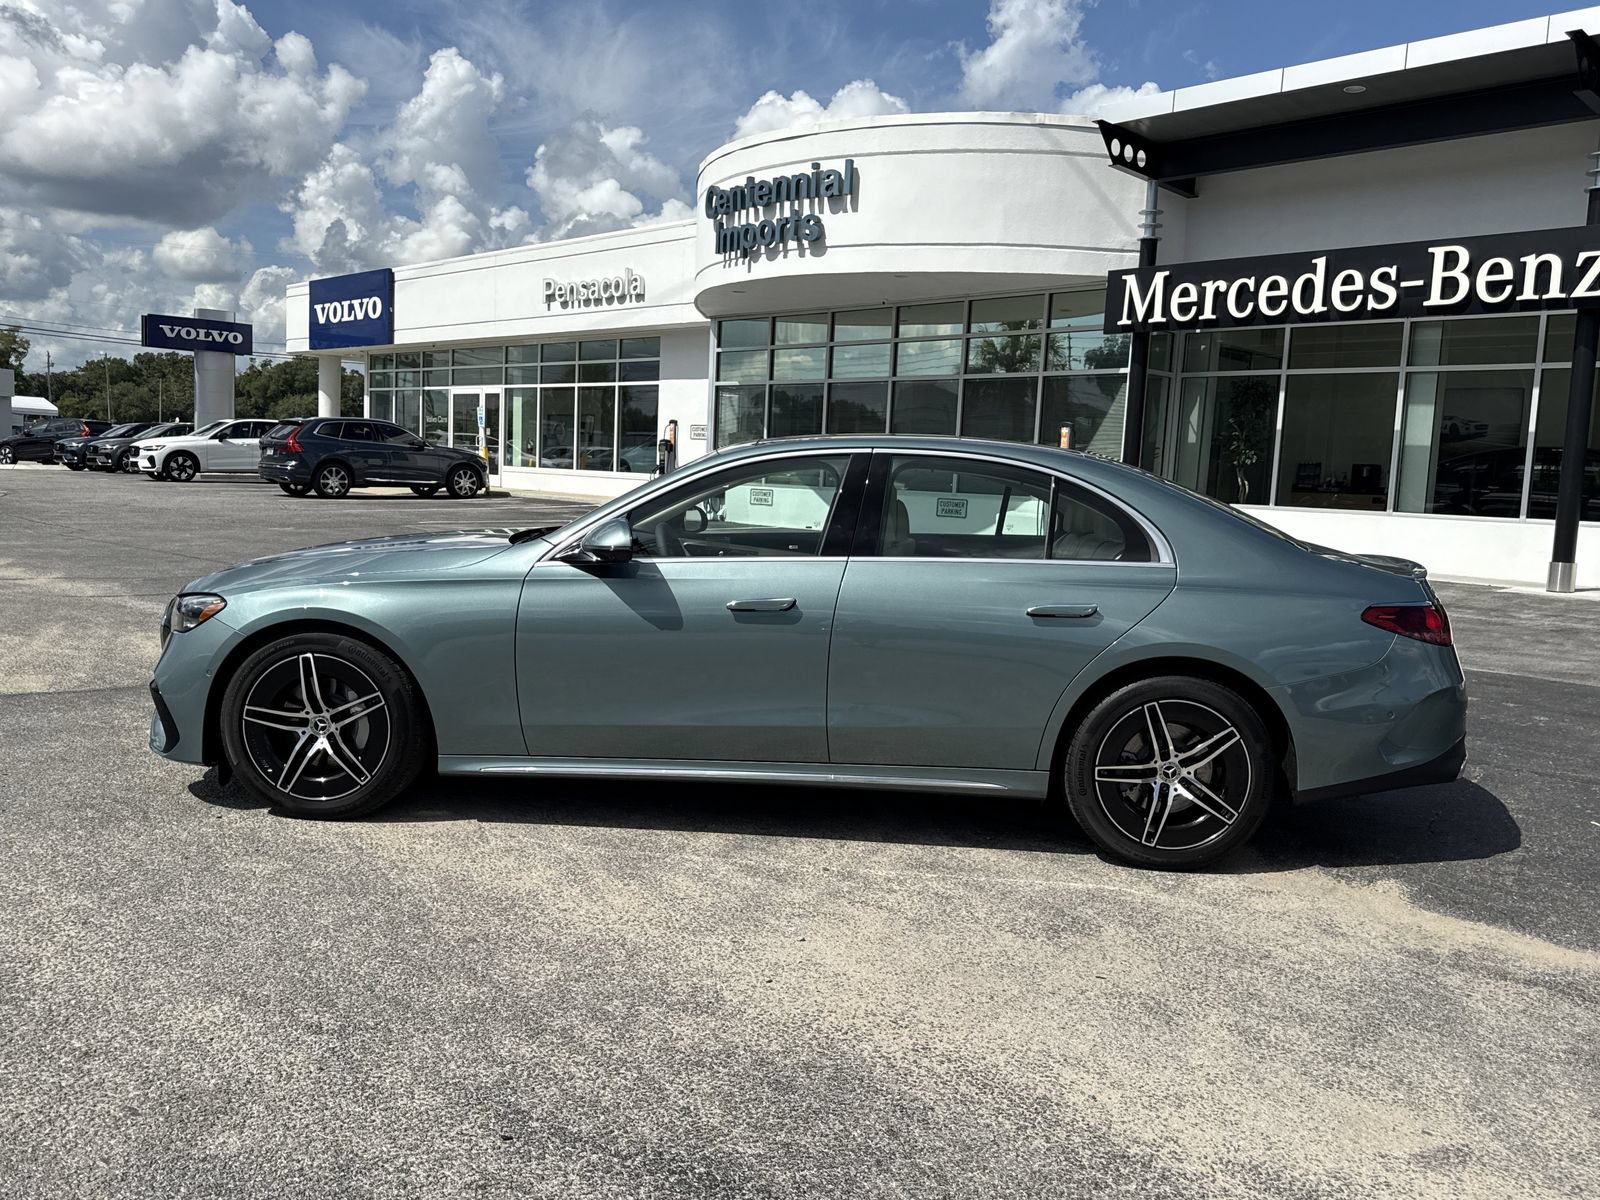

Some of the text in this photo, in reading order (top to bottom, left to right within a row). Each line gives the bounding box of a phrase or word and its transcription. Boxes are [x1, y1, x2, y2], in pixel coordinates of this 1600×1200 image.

[705, 159, 855, 220] Centennial
[714, 209, 822, 259] Imports
[542, 268, 645, 304] Pensacola
[1117, 245, 1600, 326] Mercedes-Benz
[313, 296, 382, 324] VOLVO
[159, 325, 243, 344] VOLVO
[939, 500, 965, 508] CUSTOMER
[347, 645, 389, 678] Continental
[1077, 749, 1088, 796] Continental
